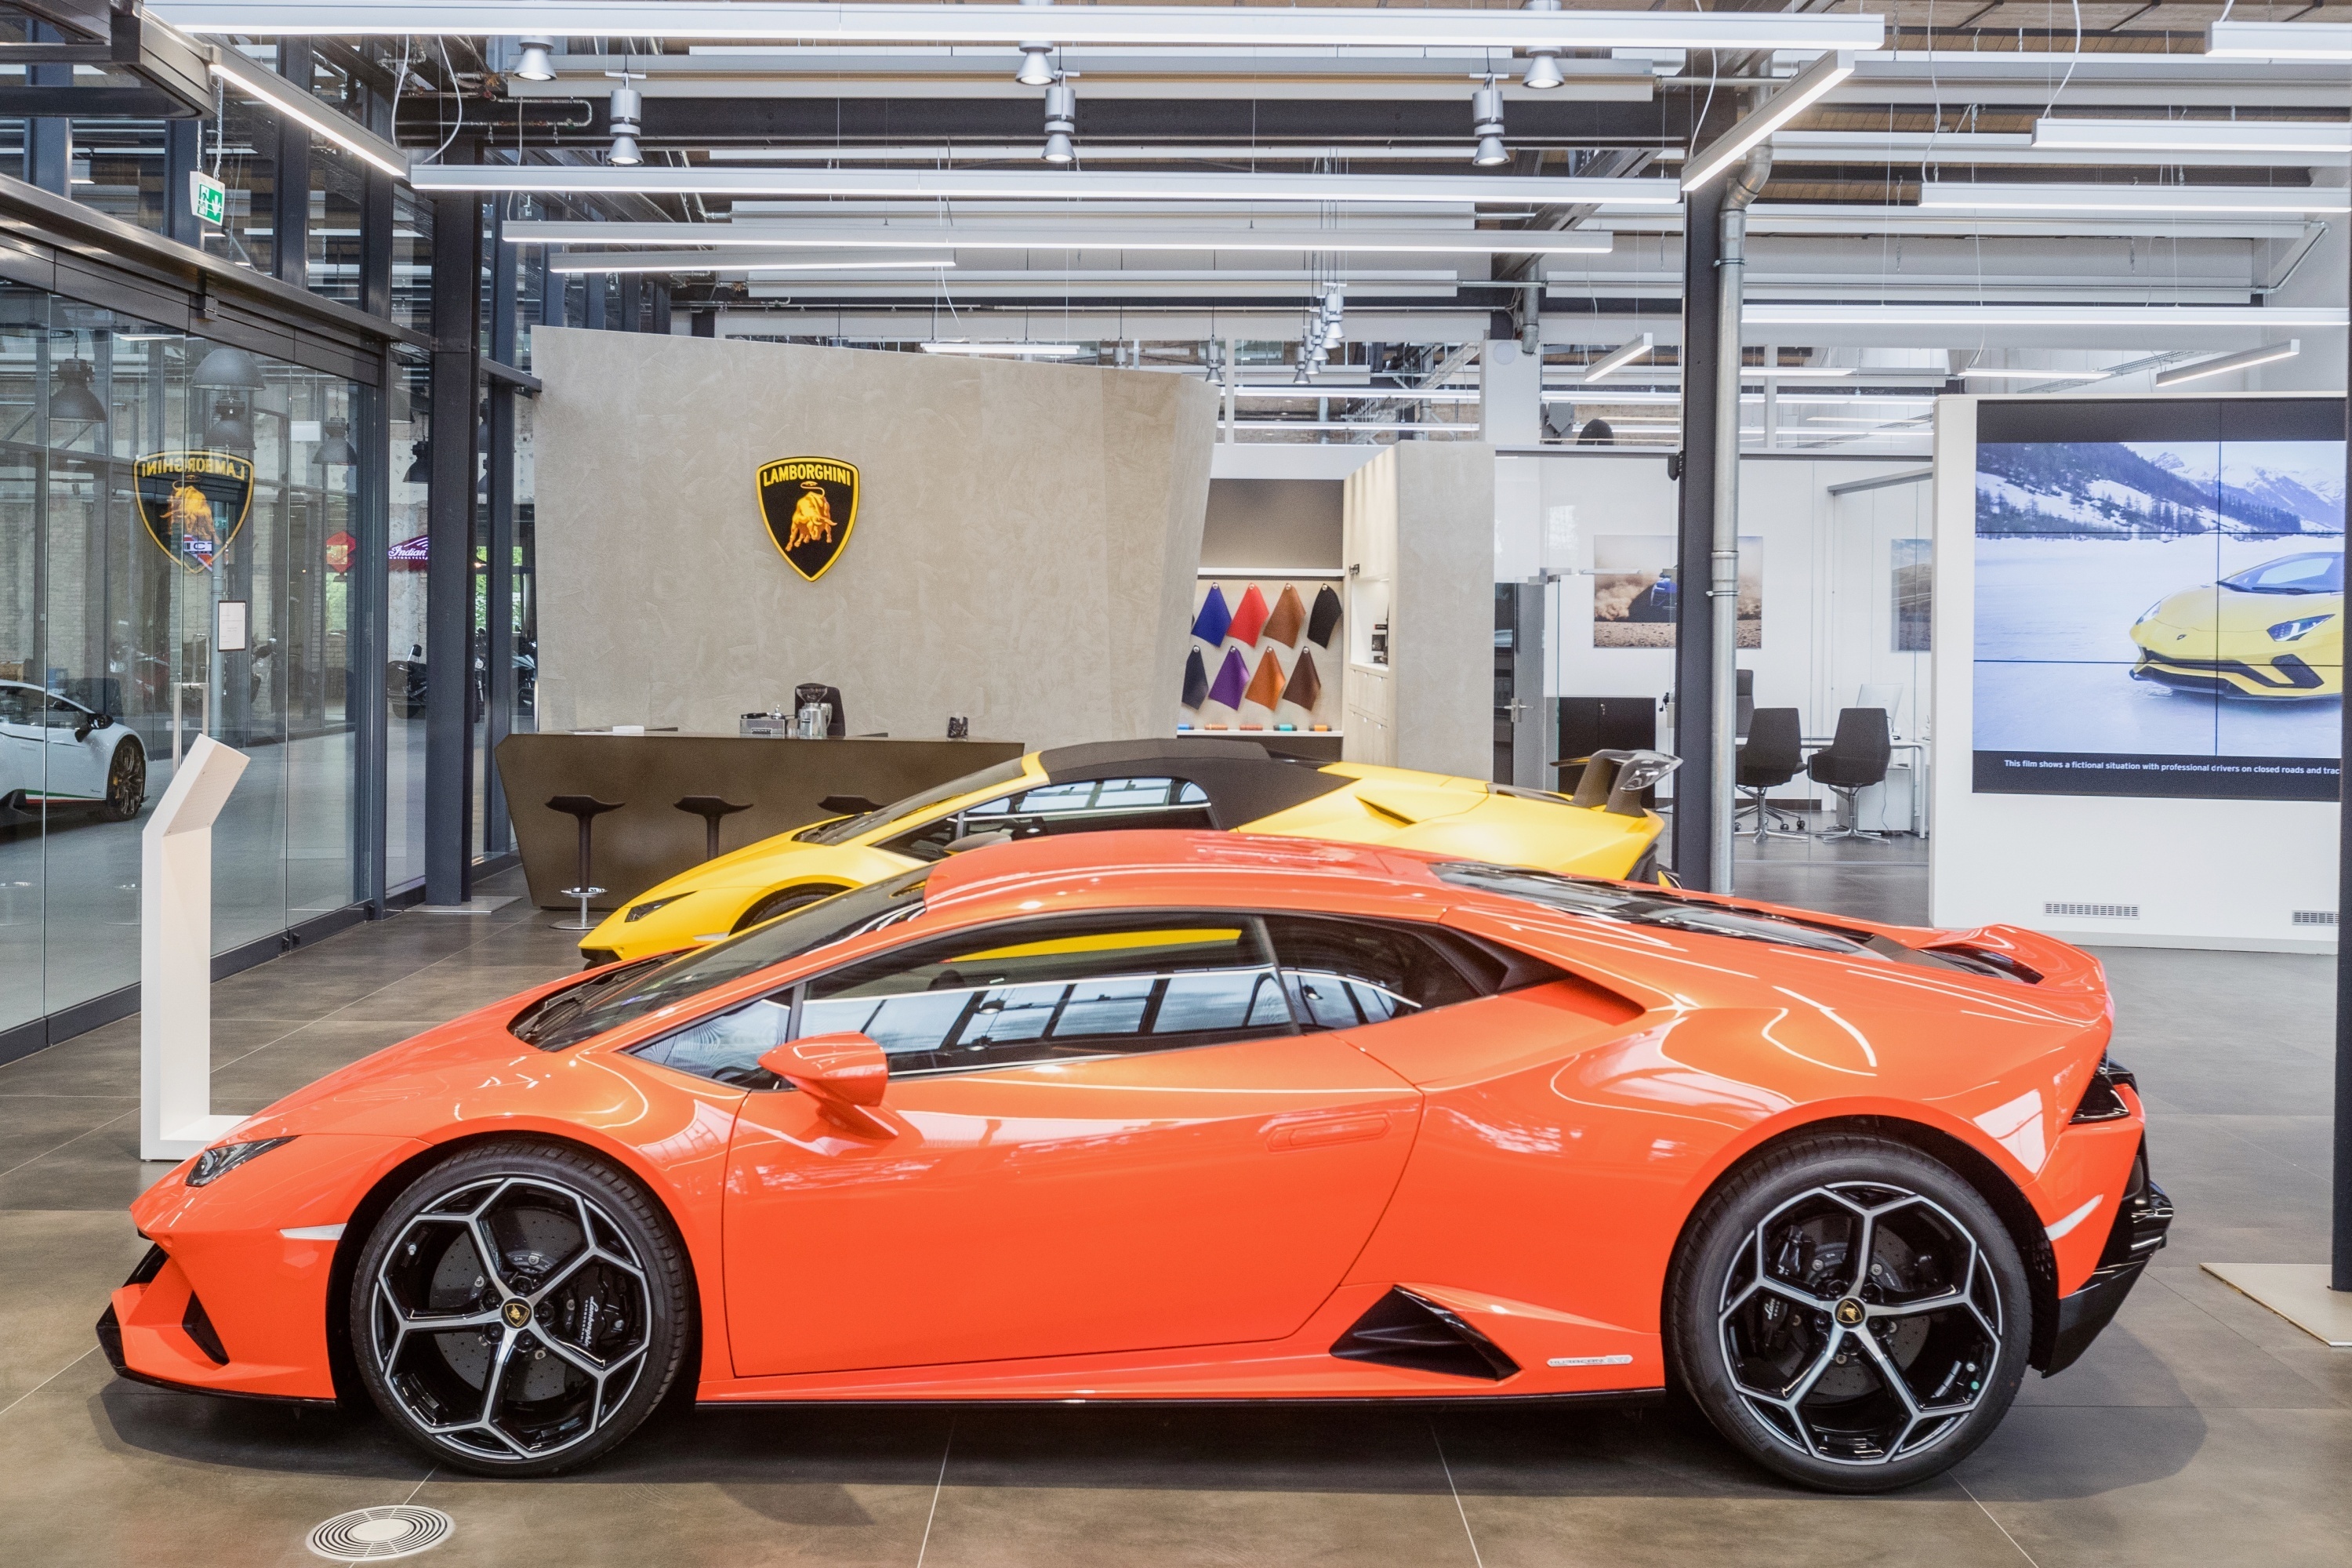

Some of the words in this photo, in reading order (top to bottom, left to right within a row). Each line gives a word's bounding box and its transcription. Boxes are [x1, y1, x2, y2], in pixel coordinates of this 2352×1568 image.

[763, 463, 851, 487] LAMBORGHINI
[388, 545, 426, 556] Indian
[2161, 764, 2210, 772] professional
[2306, 766, 2321, 775] and
